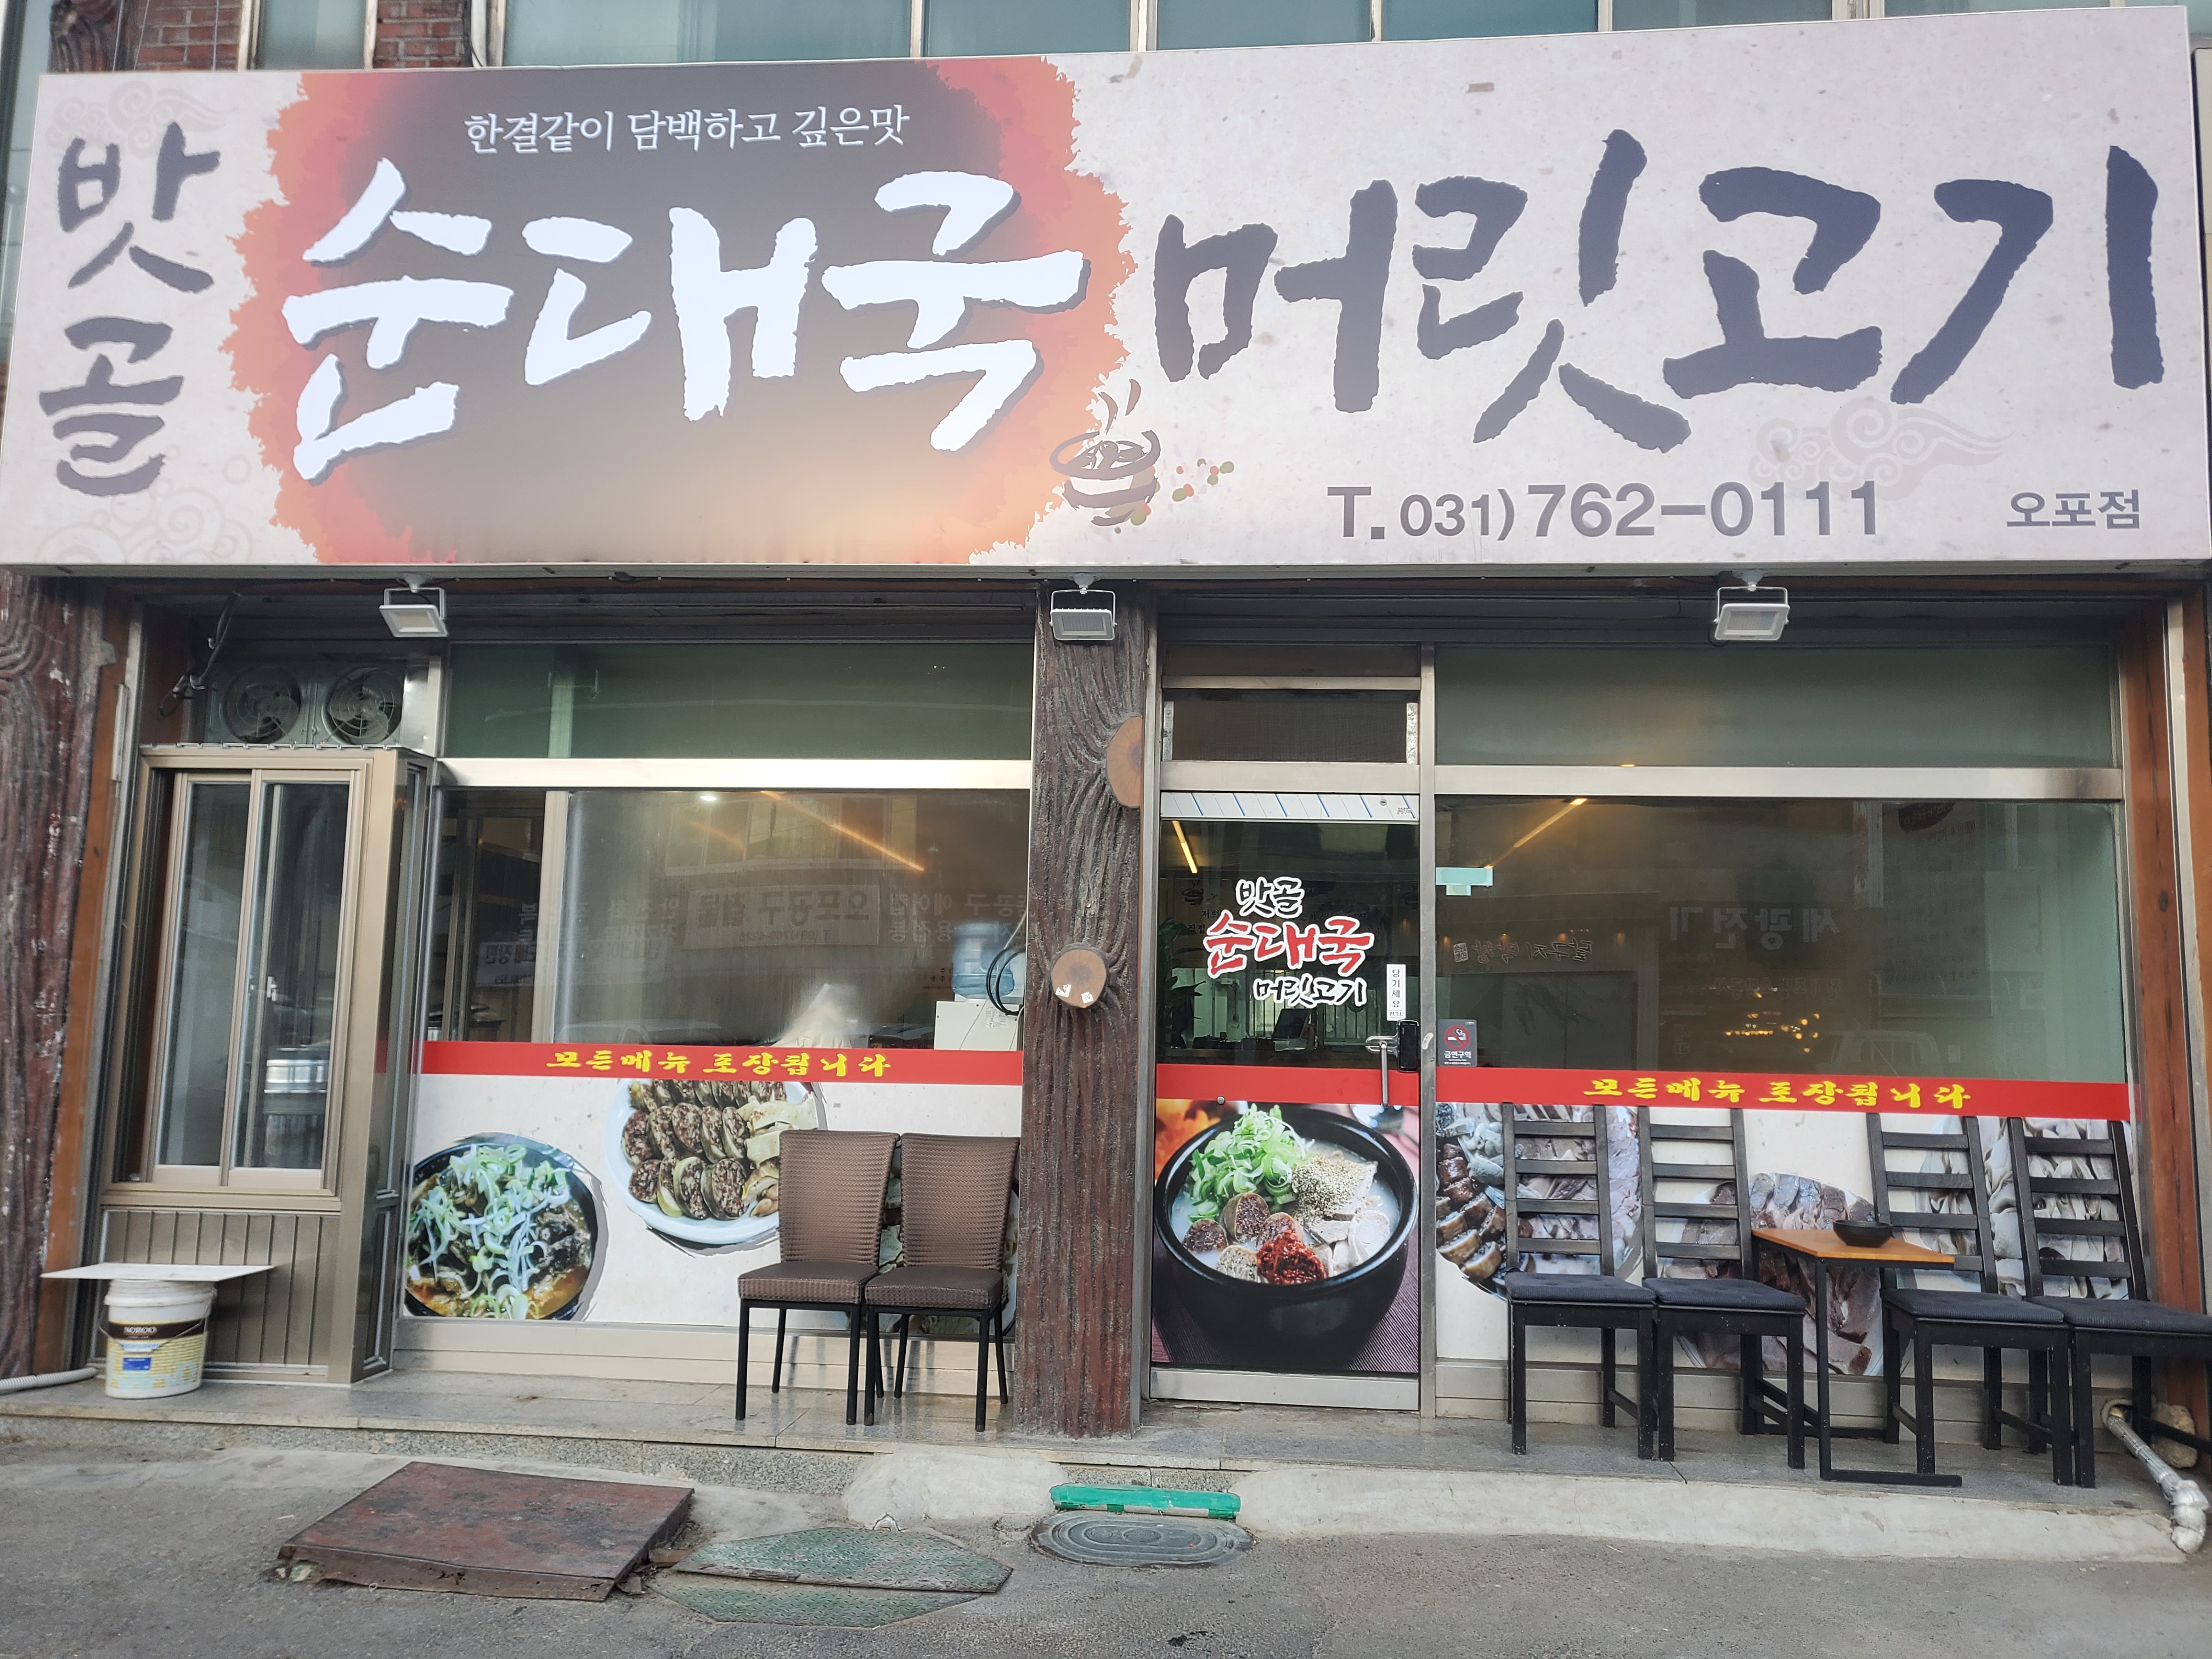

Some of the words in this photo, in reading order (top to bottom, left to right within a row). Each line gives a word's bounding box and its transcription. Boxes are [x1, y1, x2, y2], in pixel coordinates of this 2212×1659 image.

[464, 110, 615, 155] 한결같이
[627, 109, 782, 152] 담백하고
[791, 104, 911, 148] 깊은맛
[1153, 128, 2165, 454] 머릿고기
[282, 158, 1090, 484] 순대국
[1327, 486, 1386, 540] T.
[2005, 488, 2142, 531] 오포점
[1204, 909, 1375, 979] 순대국
[1253, 973, 1368, 1009] 머릿고기
[1391, 969, 1401, 1008] 당기세요
[1443, 1051, 1472, 1059] 금연구역
